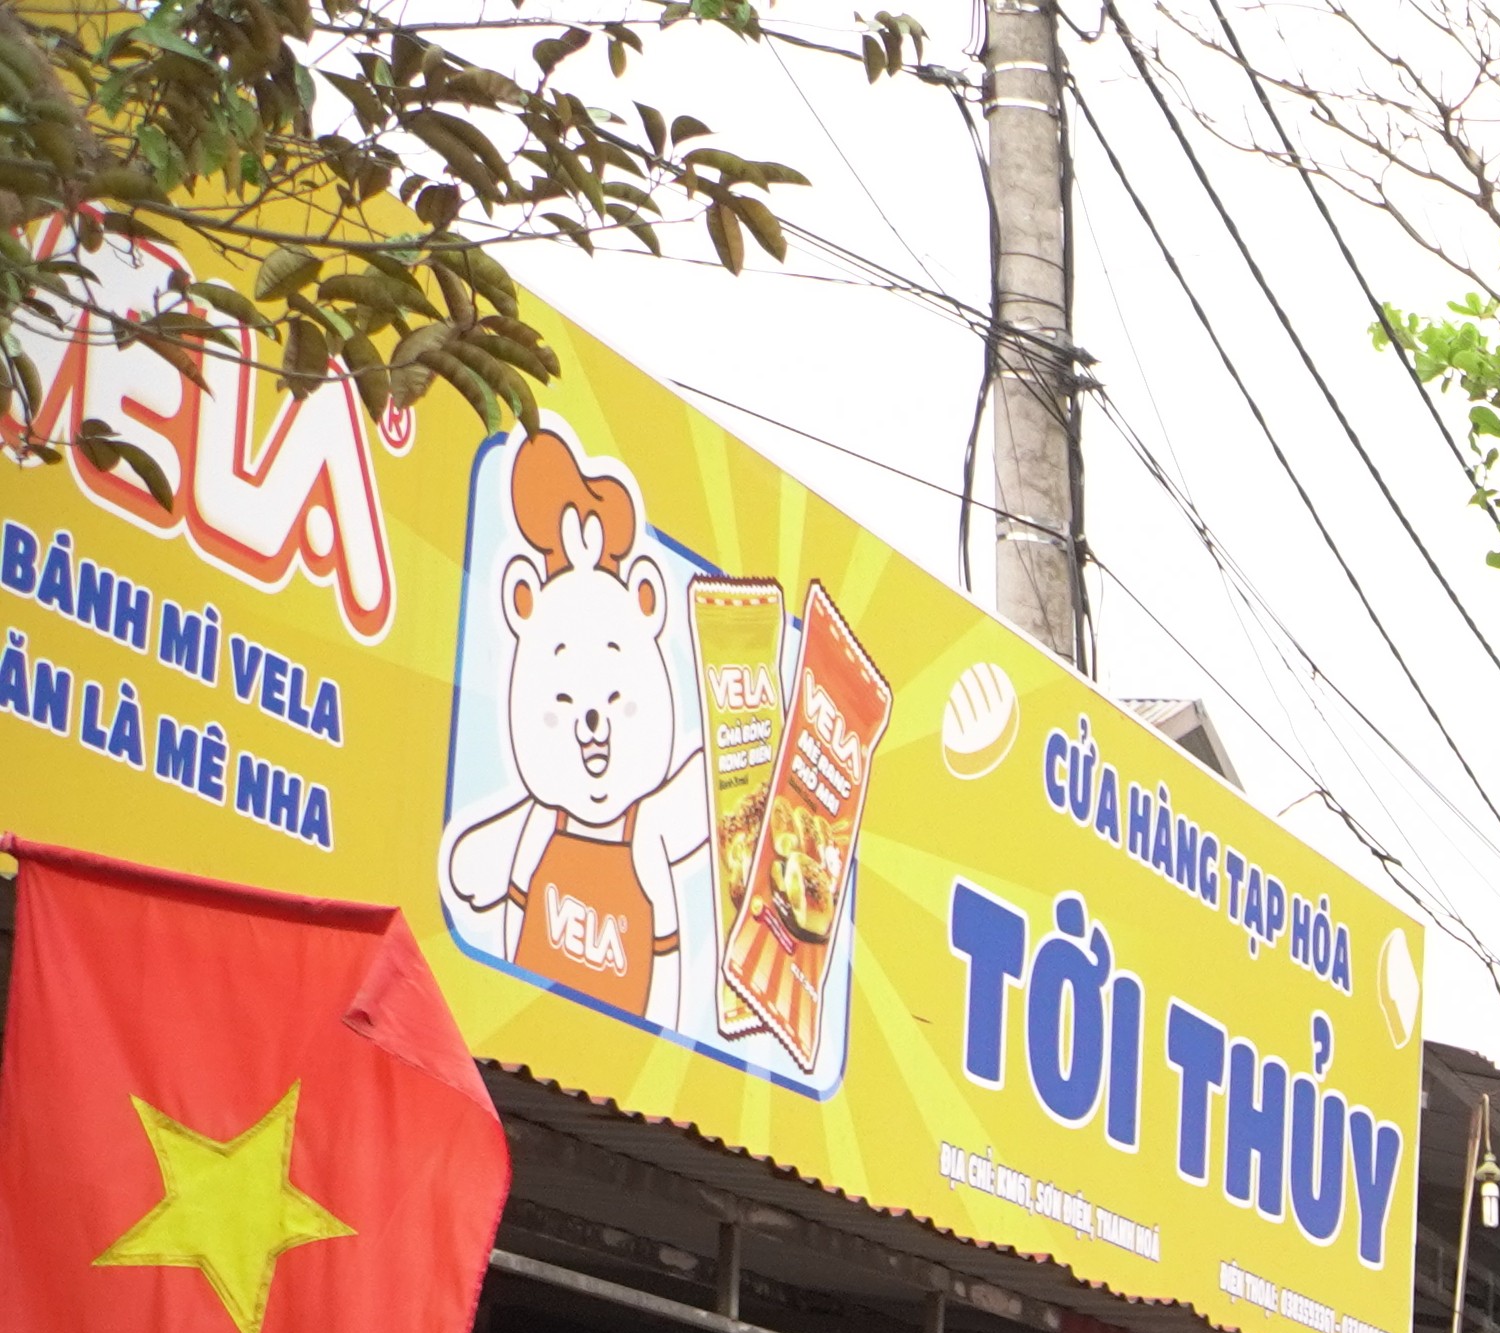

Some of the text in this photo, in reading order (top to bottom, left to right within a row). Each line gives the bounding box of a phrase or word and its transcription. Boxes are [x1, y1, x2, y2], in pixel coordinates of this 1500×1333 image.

[1, 522, 341, 743] BÁNH MÌ VELA
[707, 664, 777, 711] VELA
[0, 630, 331, 848] ĂN LÀ MÊ NHA
[803, 668, 862, 785] VELA
[1045, 717, 1120, 844] CỬA
[1127, 784, 1218, 906] HÀNG
[1226, 850, 1285, 955] TẠP
[545, 882, 628, 977] VELA
[951, 880, 1401, 1266] TỜI THỦY
[940, 1141, 965, 1190] ĐỊA
[1096, 1206, 1136, 1251] THANH
